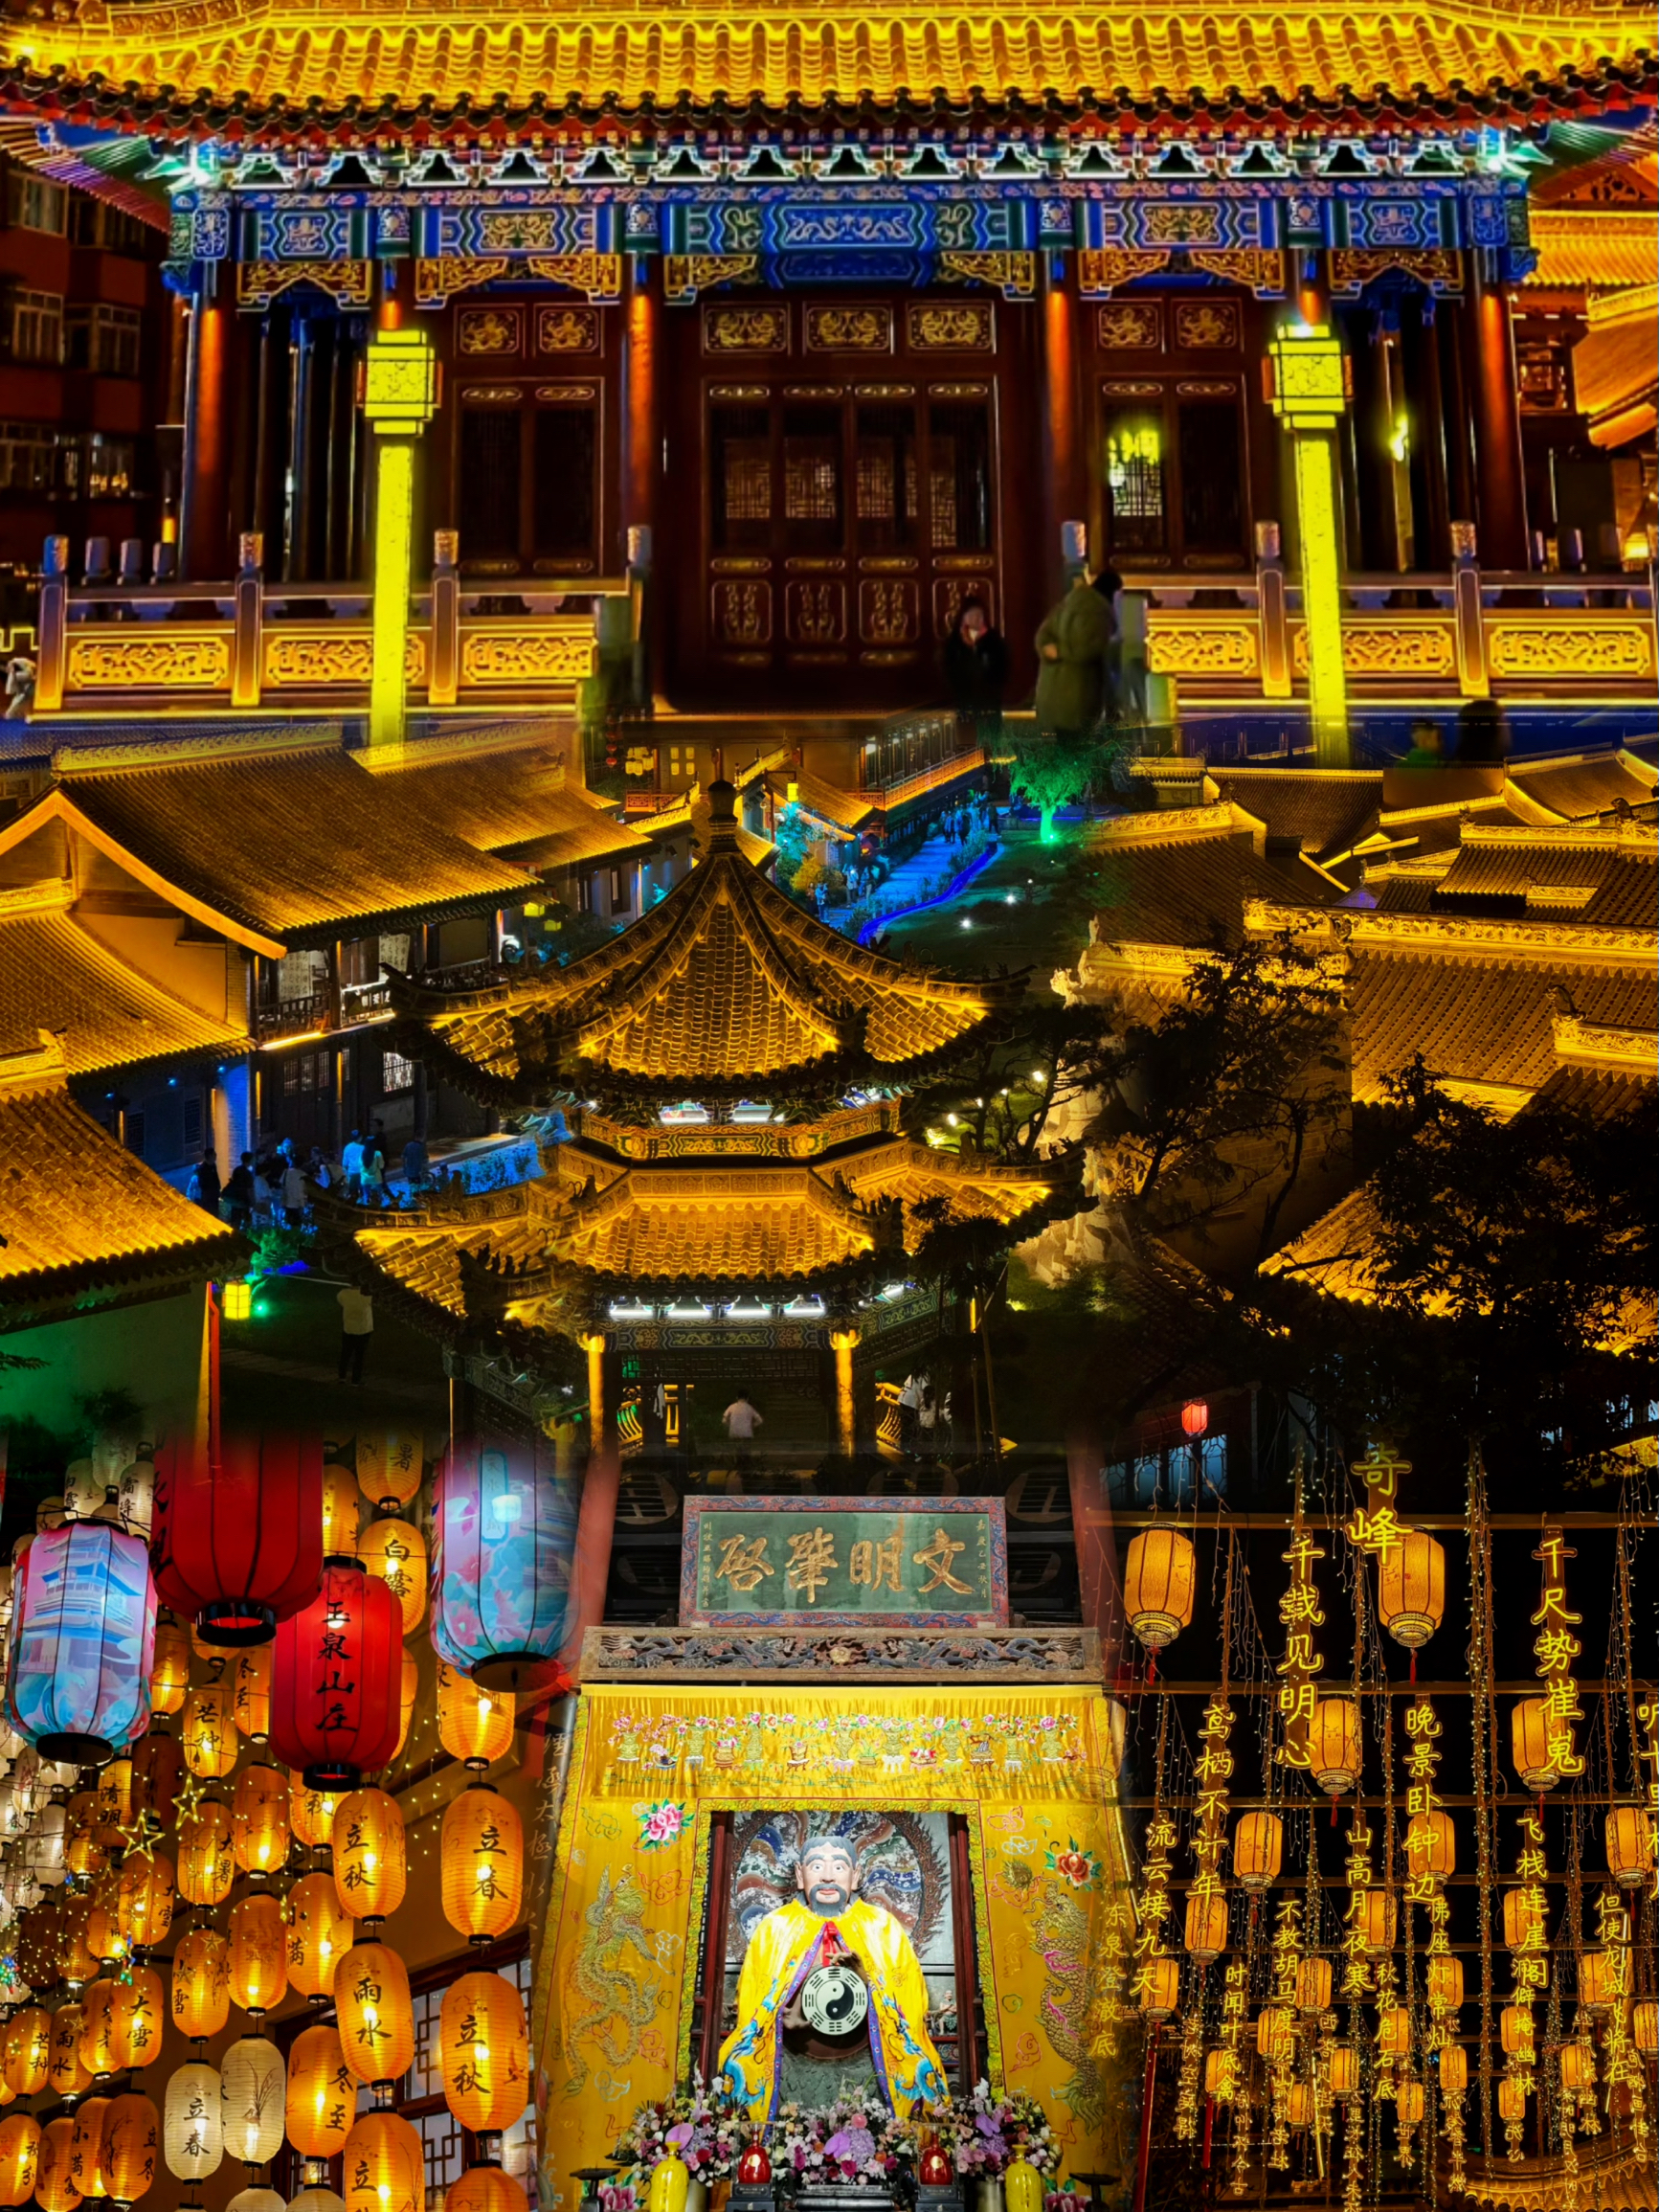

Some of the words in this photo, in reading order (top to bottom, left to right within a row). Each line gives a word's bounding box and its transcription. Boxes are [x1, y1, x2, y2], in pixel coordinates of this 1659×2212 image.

[383, 1539, 413, 1598] 白露
[1344, 1443, 1414, 1565] 奇峰
[235, 1657, 257, 1710] 冬至
[315, 1600, 360, 1733] 玉泉山庄
[1277, 1538, 1326, 1767] 千载见明心
[1531, 1537, 1584, 1774] 千尺势崔嵬
[343, 1822, 376, 1892] 立秋
[470, 1824, 509, 1902] 立春
[1401, 1704, 1443, 1901] 晚景卧钟边
[1130, 1818, 1177, 1998] 流云接九天
[1341, 1820, 1377, 1998] 山高月夜寒
[1516, 1817, 1549, 1989] 飞栈连崖阁
[126, 1995, 153, 2048] 大雪
[352, 1976, 392, 2048] 雨水
[1215, 1963, 1248, 2102] 时闻叶底禽
[1270, 1900, 1304, 2091] 不教胡马度阴山
[1373, 1962, 1400, 2101] 秋花危石底
[1424, 1896, 1453, 2054] 佛座灯常灿
[1594, 1892, 1632, 2084] 但使龙城飞将在
[52, 2029, 75, 2078] 雨水
[325, 2065, 354, 2133] 冬至
[452, 2014, 492, 2096] 立秋
[181, 2097, 211, 2158] 立春
